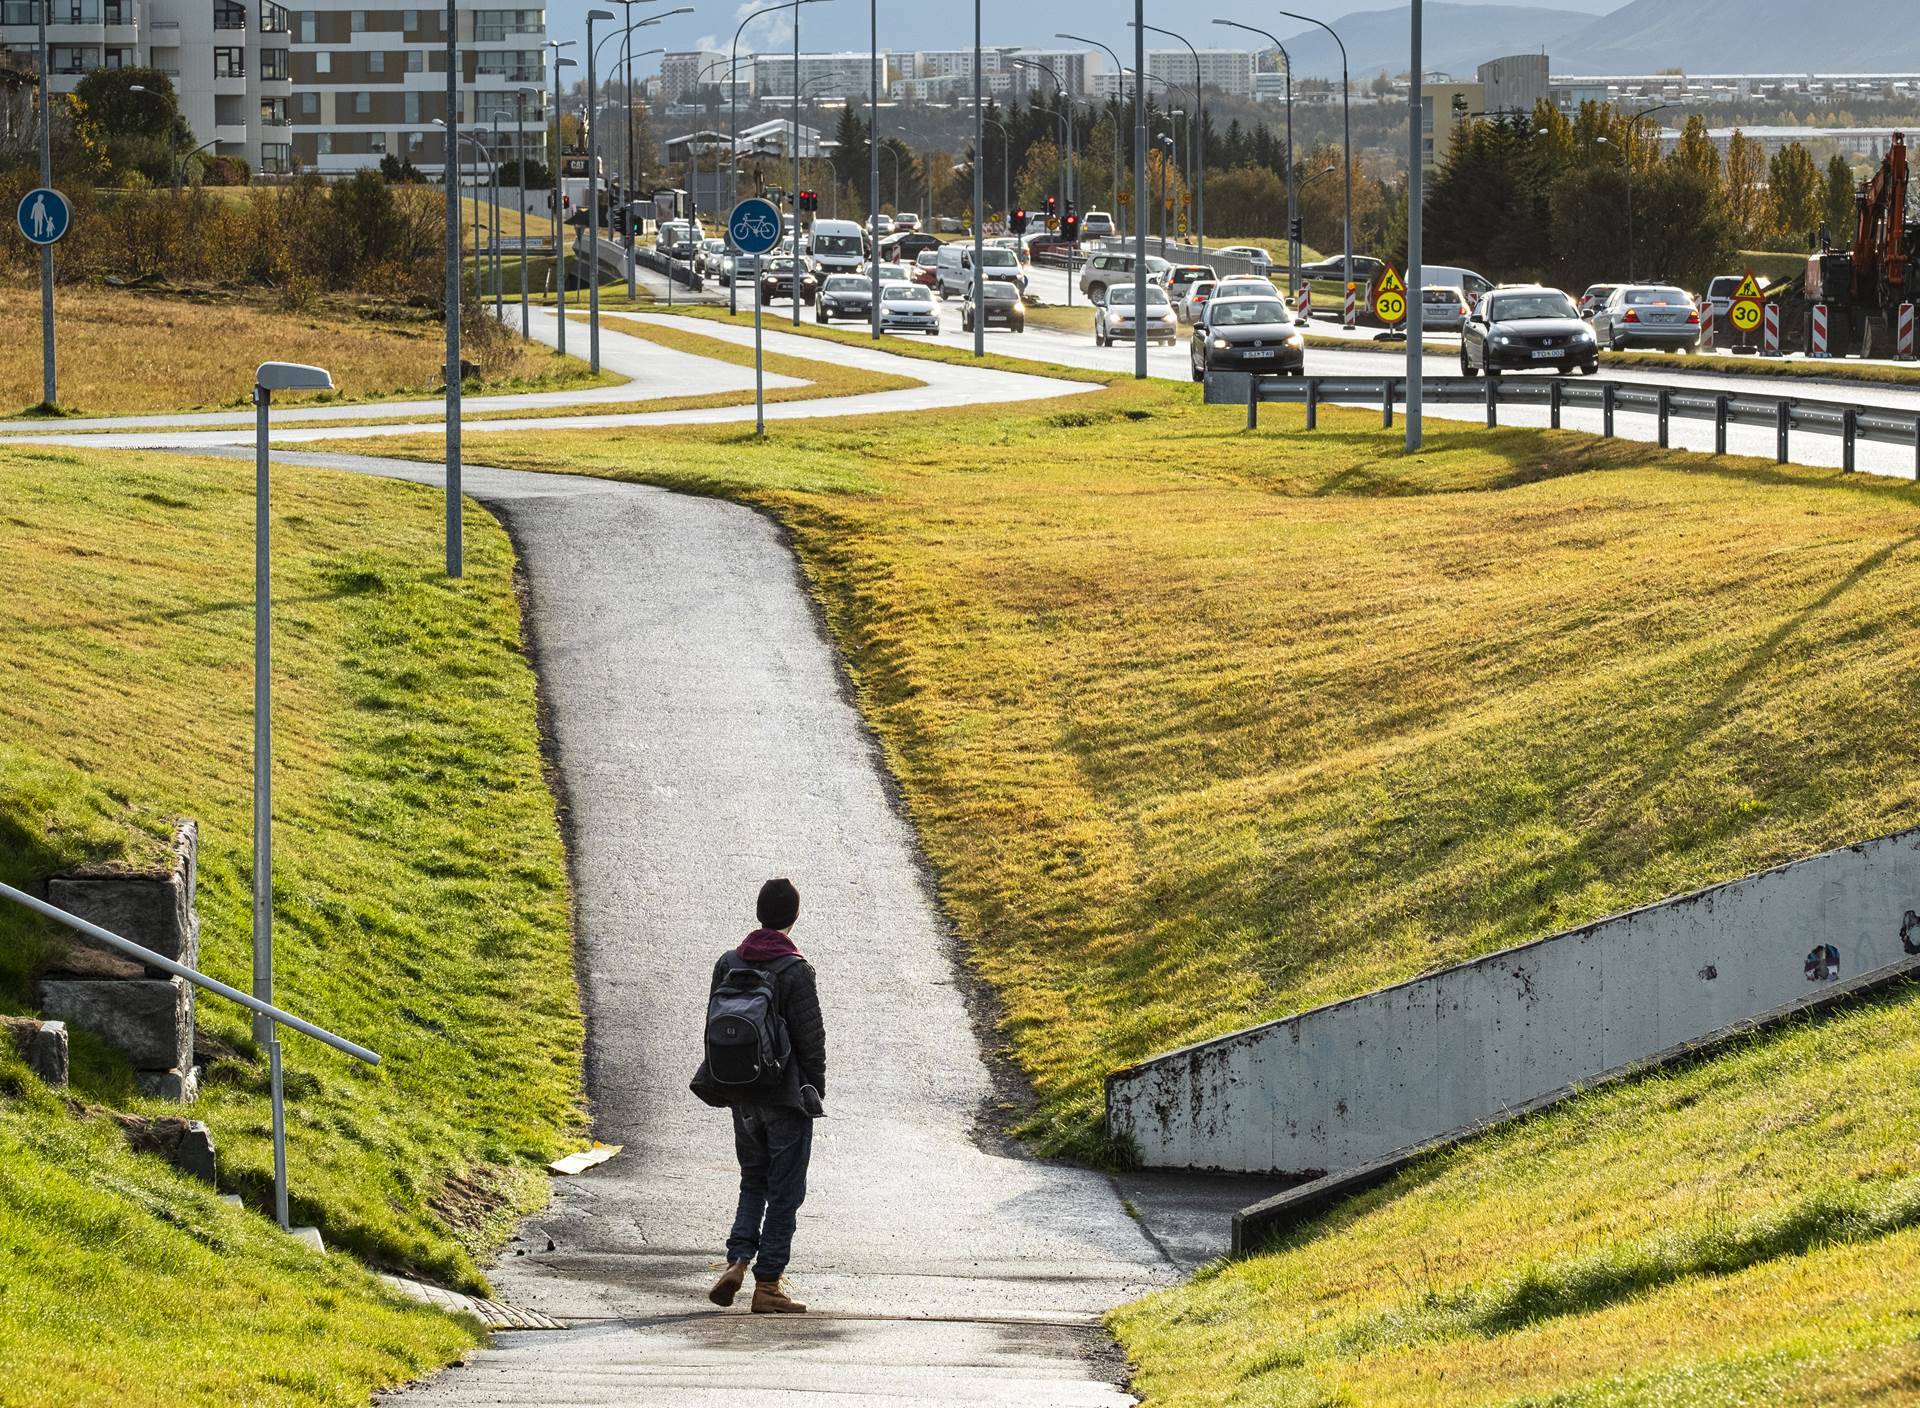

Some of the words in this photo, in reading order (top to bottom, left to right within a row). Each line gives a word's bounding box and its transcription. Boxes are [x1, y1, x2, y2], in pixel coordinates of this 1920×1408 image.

[570, 160, 584, 169] CAT
[1379, 299, 1402, 313] 30
[1735, 306, 1758, 322] 30
